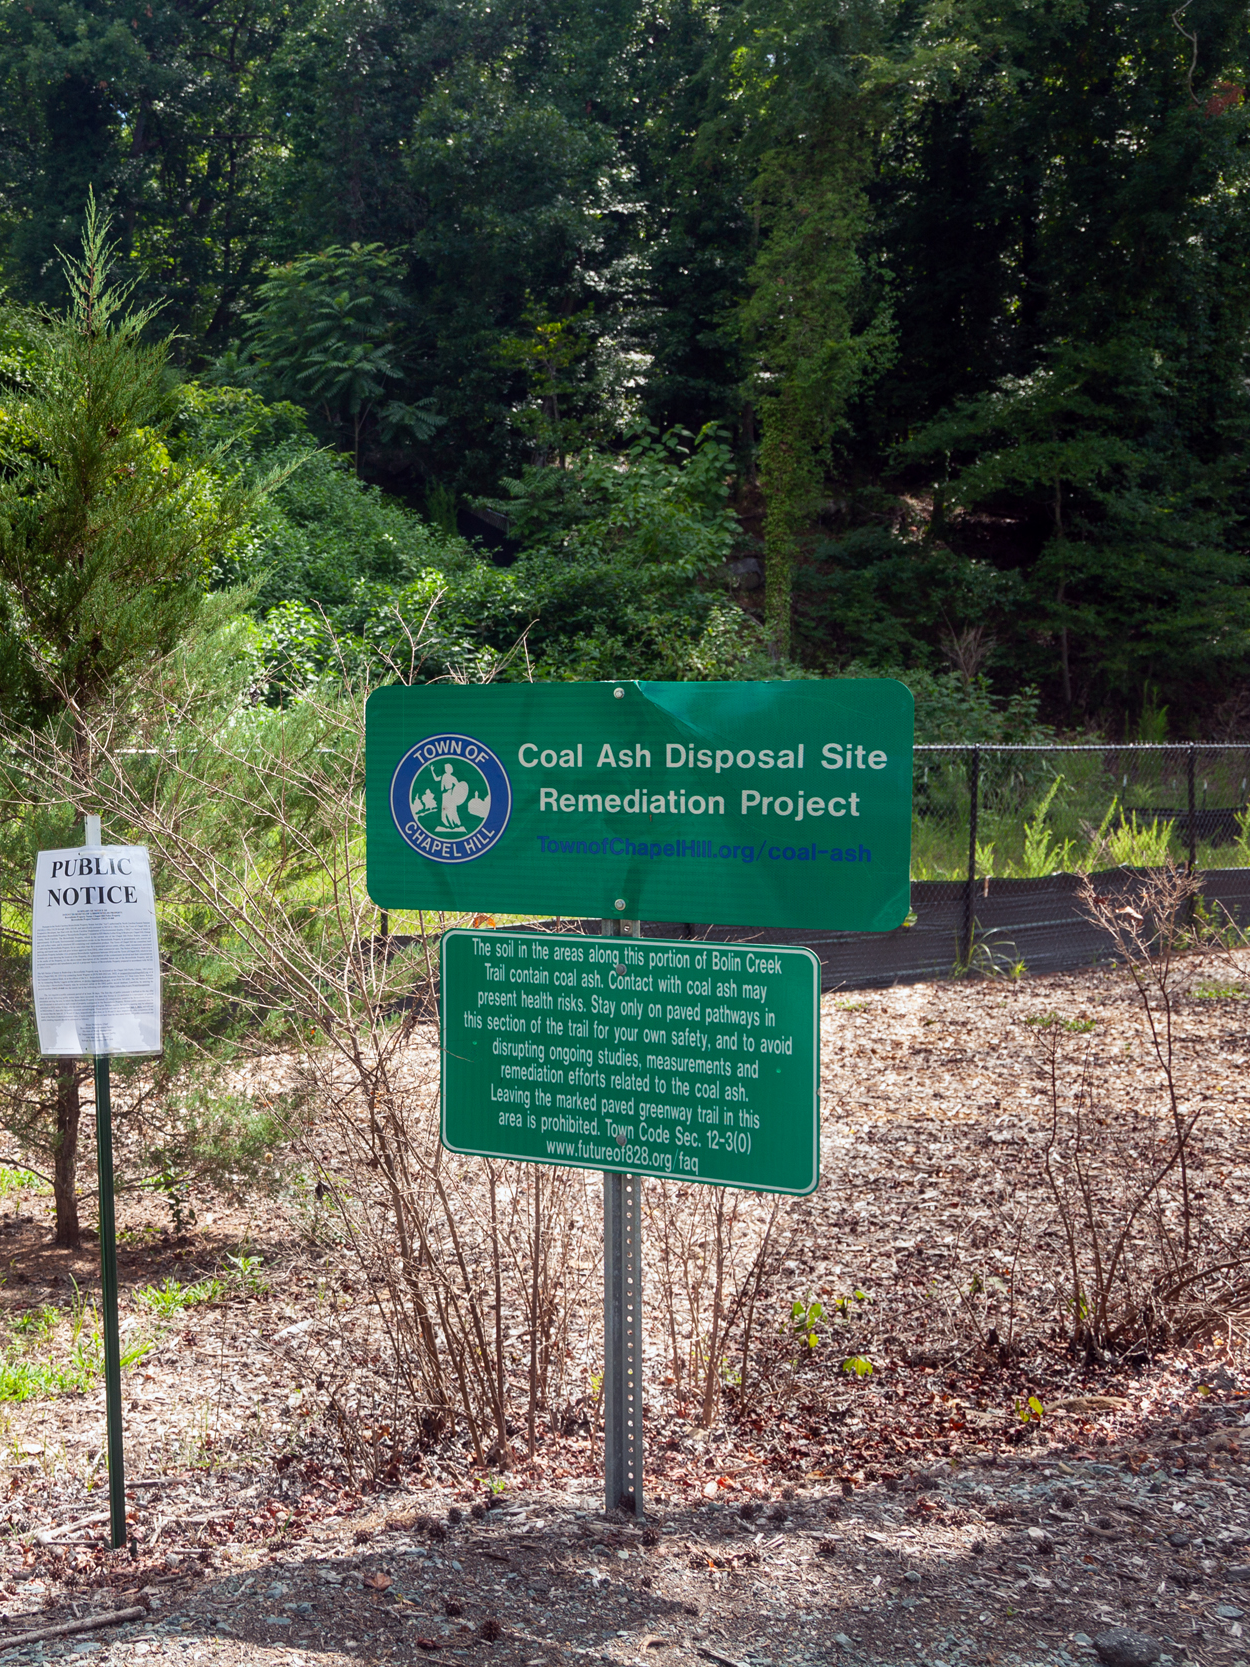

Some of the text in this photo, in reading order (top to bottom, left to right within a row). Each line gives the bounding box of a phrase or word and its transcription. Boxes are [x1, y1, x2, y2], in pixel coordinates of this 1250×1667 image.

[413, 740, 489, 764] TOWN OF
[518, 742, 888, 774] Coal Ash Disposal Site
[539, 787, 860, 821] Remediation Project
[405, 821, 495, 857] CHAPEL HILL
[536, 834, 873, 864] TownofChapelHill.org/coal-ash
[51, 857, 132, 878] PUBLIC
[47, 885, 138, 907] NOTICE
[472, 937, 782, 974] The soil in the areas along this portion of Bolin Creek
[484, 962, 767, 1004] Trail contain coal ash. Contact with coal ash may
[478, 990, 775, 1029] present health risks. Stay only on paved pathways in
[463, 1011, 793, 1055] this section of the trail for your own safety, and to avoid
[492, 1037, 759, 1079] disrupting ongoing studies, measurements and
[501, 1063, 749, 1102] remediation efforts related to the coal ash.
[491, 1083, 760, 1129] Leaving the marked paved greenway trail in this
[498, 1111, 522, 1127] area
[527, 1112, 536, 1128] is
[541, 1114, 600, 1136] prohibited.
[605, 1118, 634, 1140] Town
[639, 1121, 670, 1143] Code
[676, 1126, 701, 1145] Sec.
[546, 1139, 699, 1174] www.futureof828.org/faq
